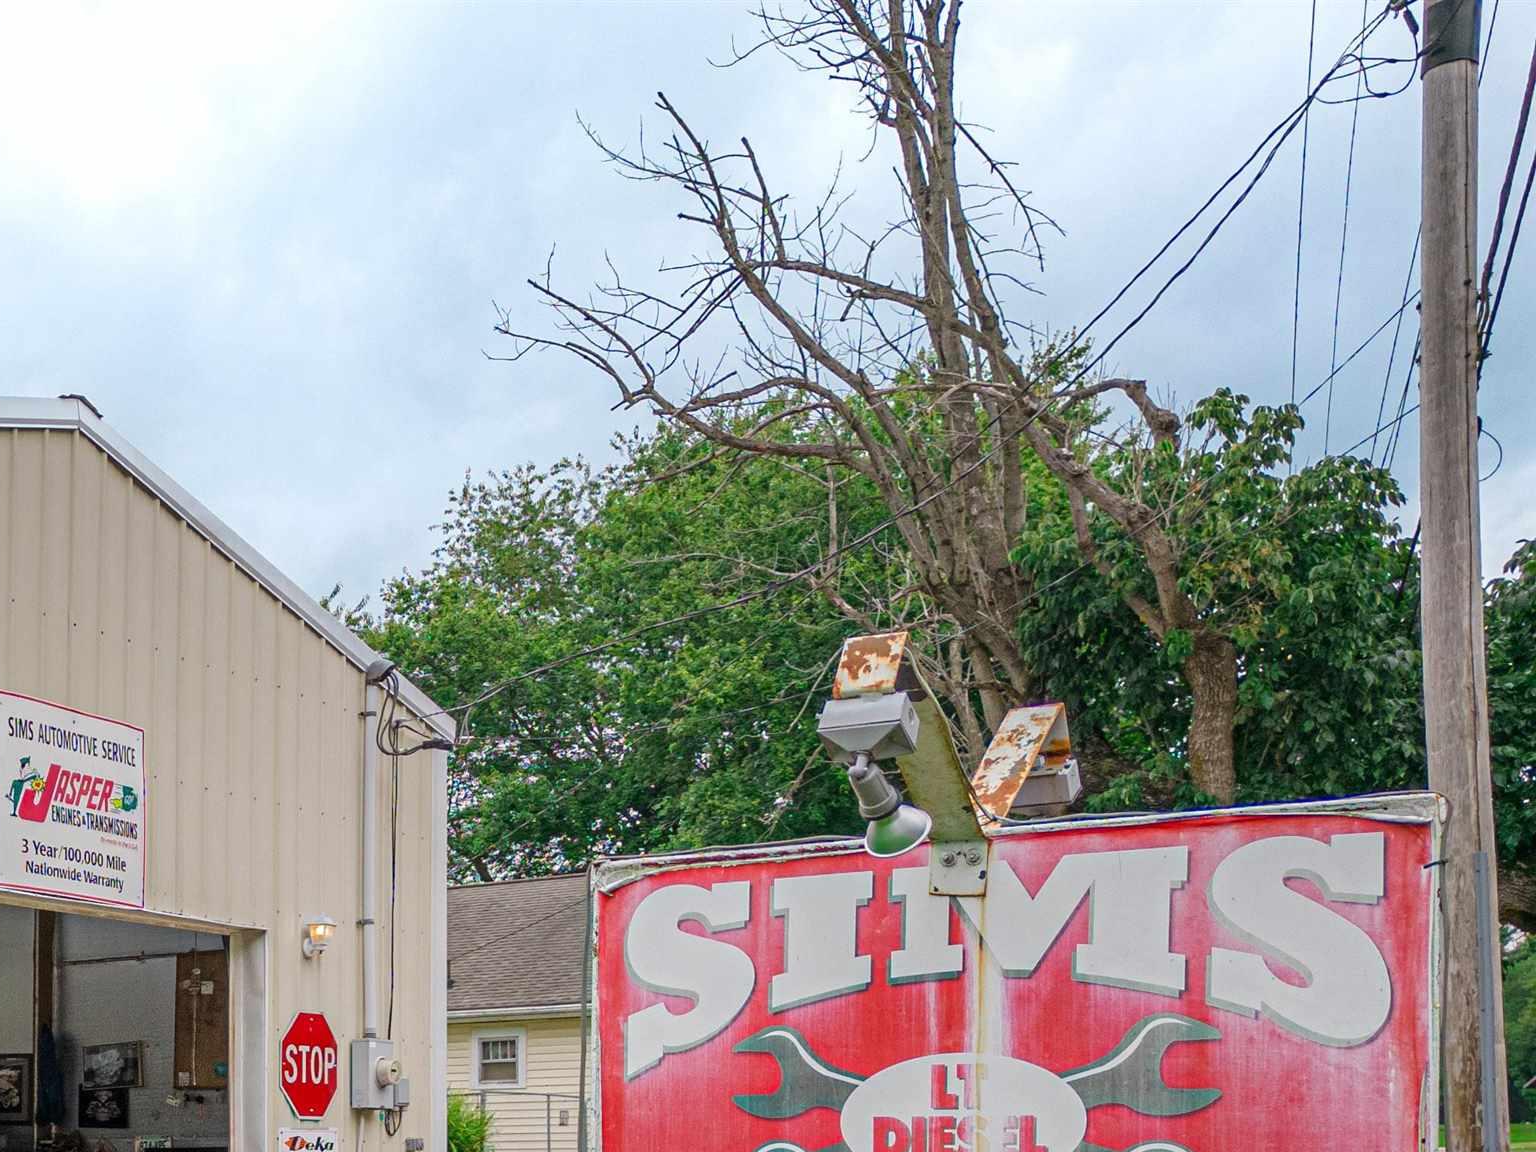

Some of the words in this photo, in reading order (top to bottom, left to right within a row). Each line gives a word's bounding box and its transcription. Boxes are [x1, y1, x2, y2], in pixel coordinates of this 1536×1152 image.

[7, 716, 34, 741] SIMS
[38, 723, 98, 758] AUTOMOTIVE
[102, 739, 136, 767] SERVICE
[18, 763, 115, 823] JASPER
[51, 804, 81, 828] ENGINES
[86, 812, 138, 840] TRANSMISSIONS
[21, 838, 29, 854] 3
[32, 839, 104, 867] Year/100,000
[106, 854, 126, 873] Mile
[25, 860, 82, 882] Nationwide
[84, 870, 124, 893] Warranty
[624, 830, 1394, 1081] SIMS
[284, 1043, 337, 1085] STOP
[930, 1063, 989, 1110] LT
[285, 1135, 335, 1152] Deka
